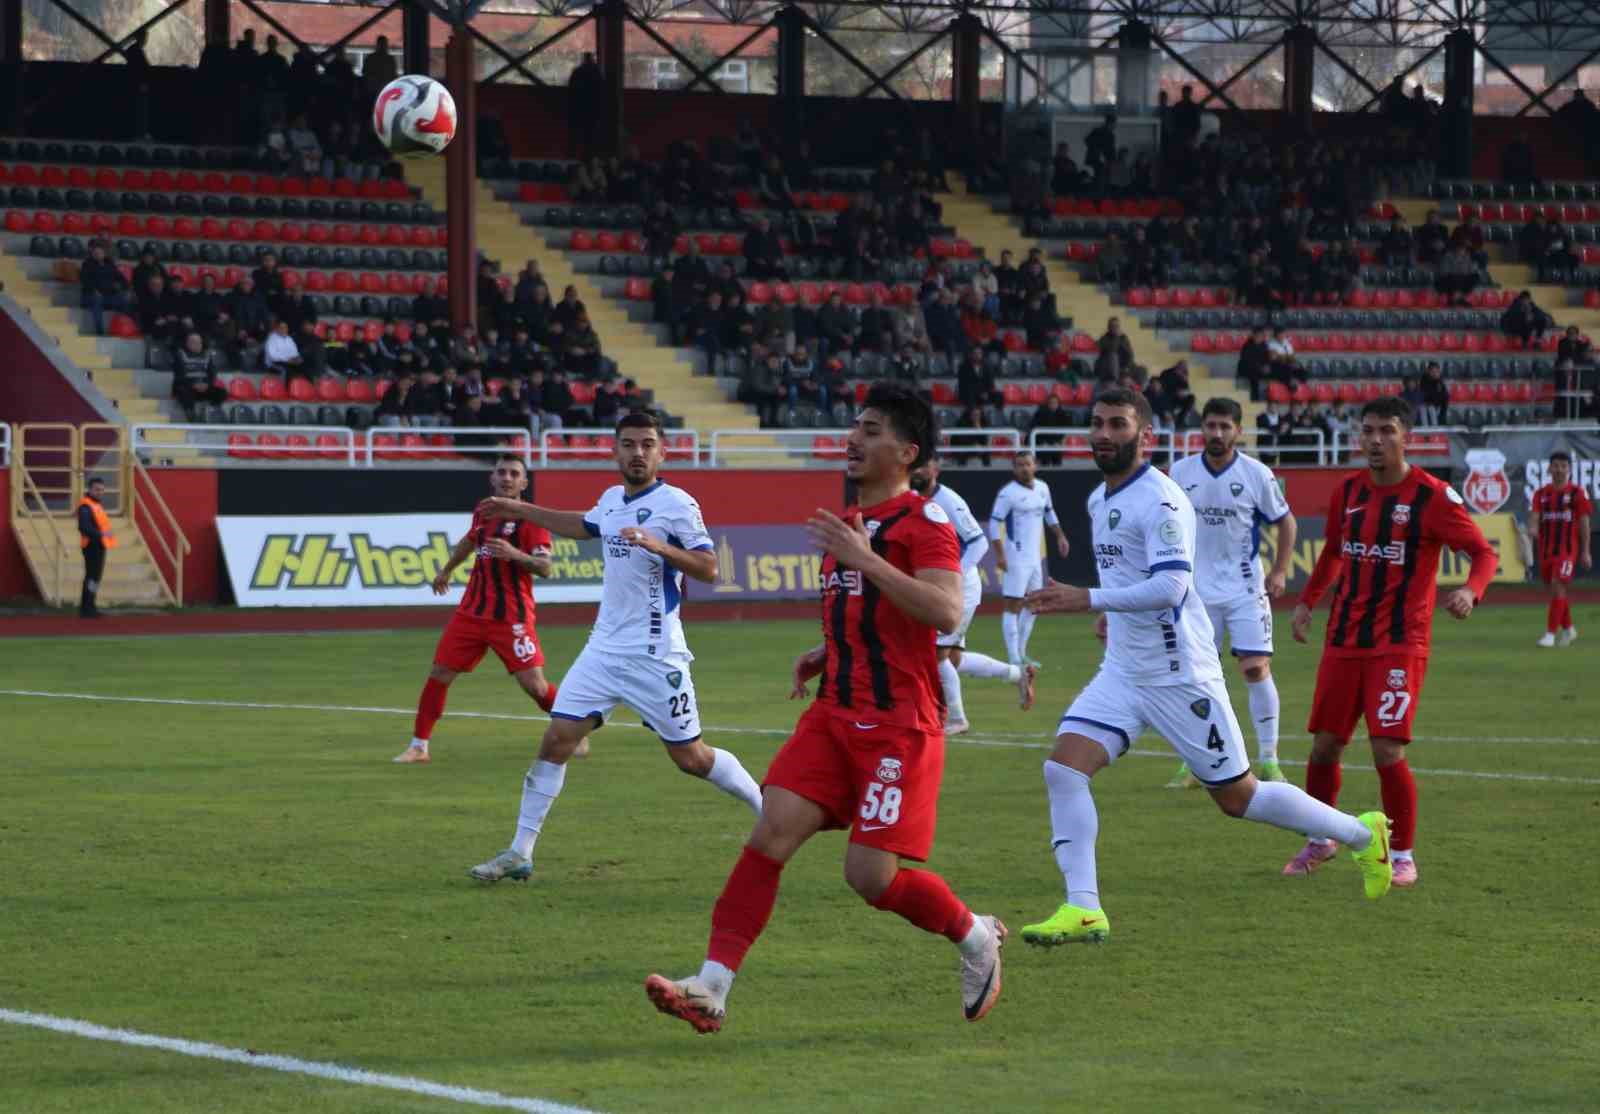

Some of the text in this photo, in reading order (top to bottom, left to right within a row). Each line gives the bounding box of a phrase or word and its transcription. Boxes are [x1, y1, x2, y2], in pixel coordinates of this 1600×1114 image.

[513, 636, 536, 658] 66
[669, 692, 690, 718] 22
[1378, 691, 1411, 720] 27
[1208, 723, 1224, 753] 4
[861, 782, 902, 825] 58
